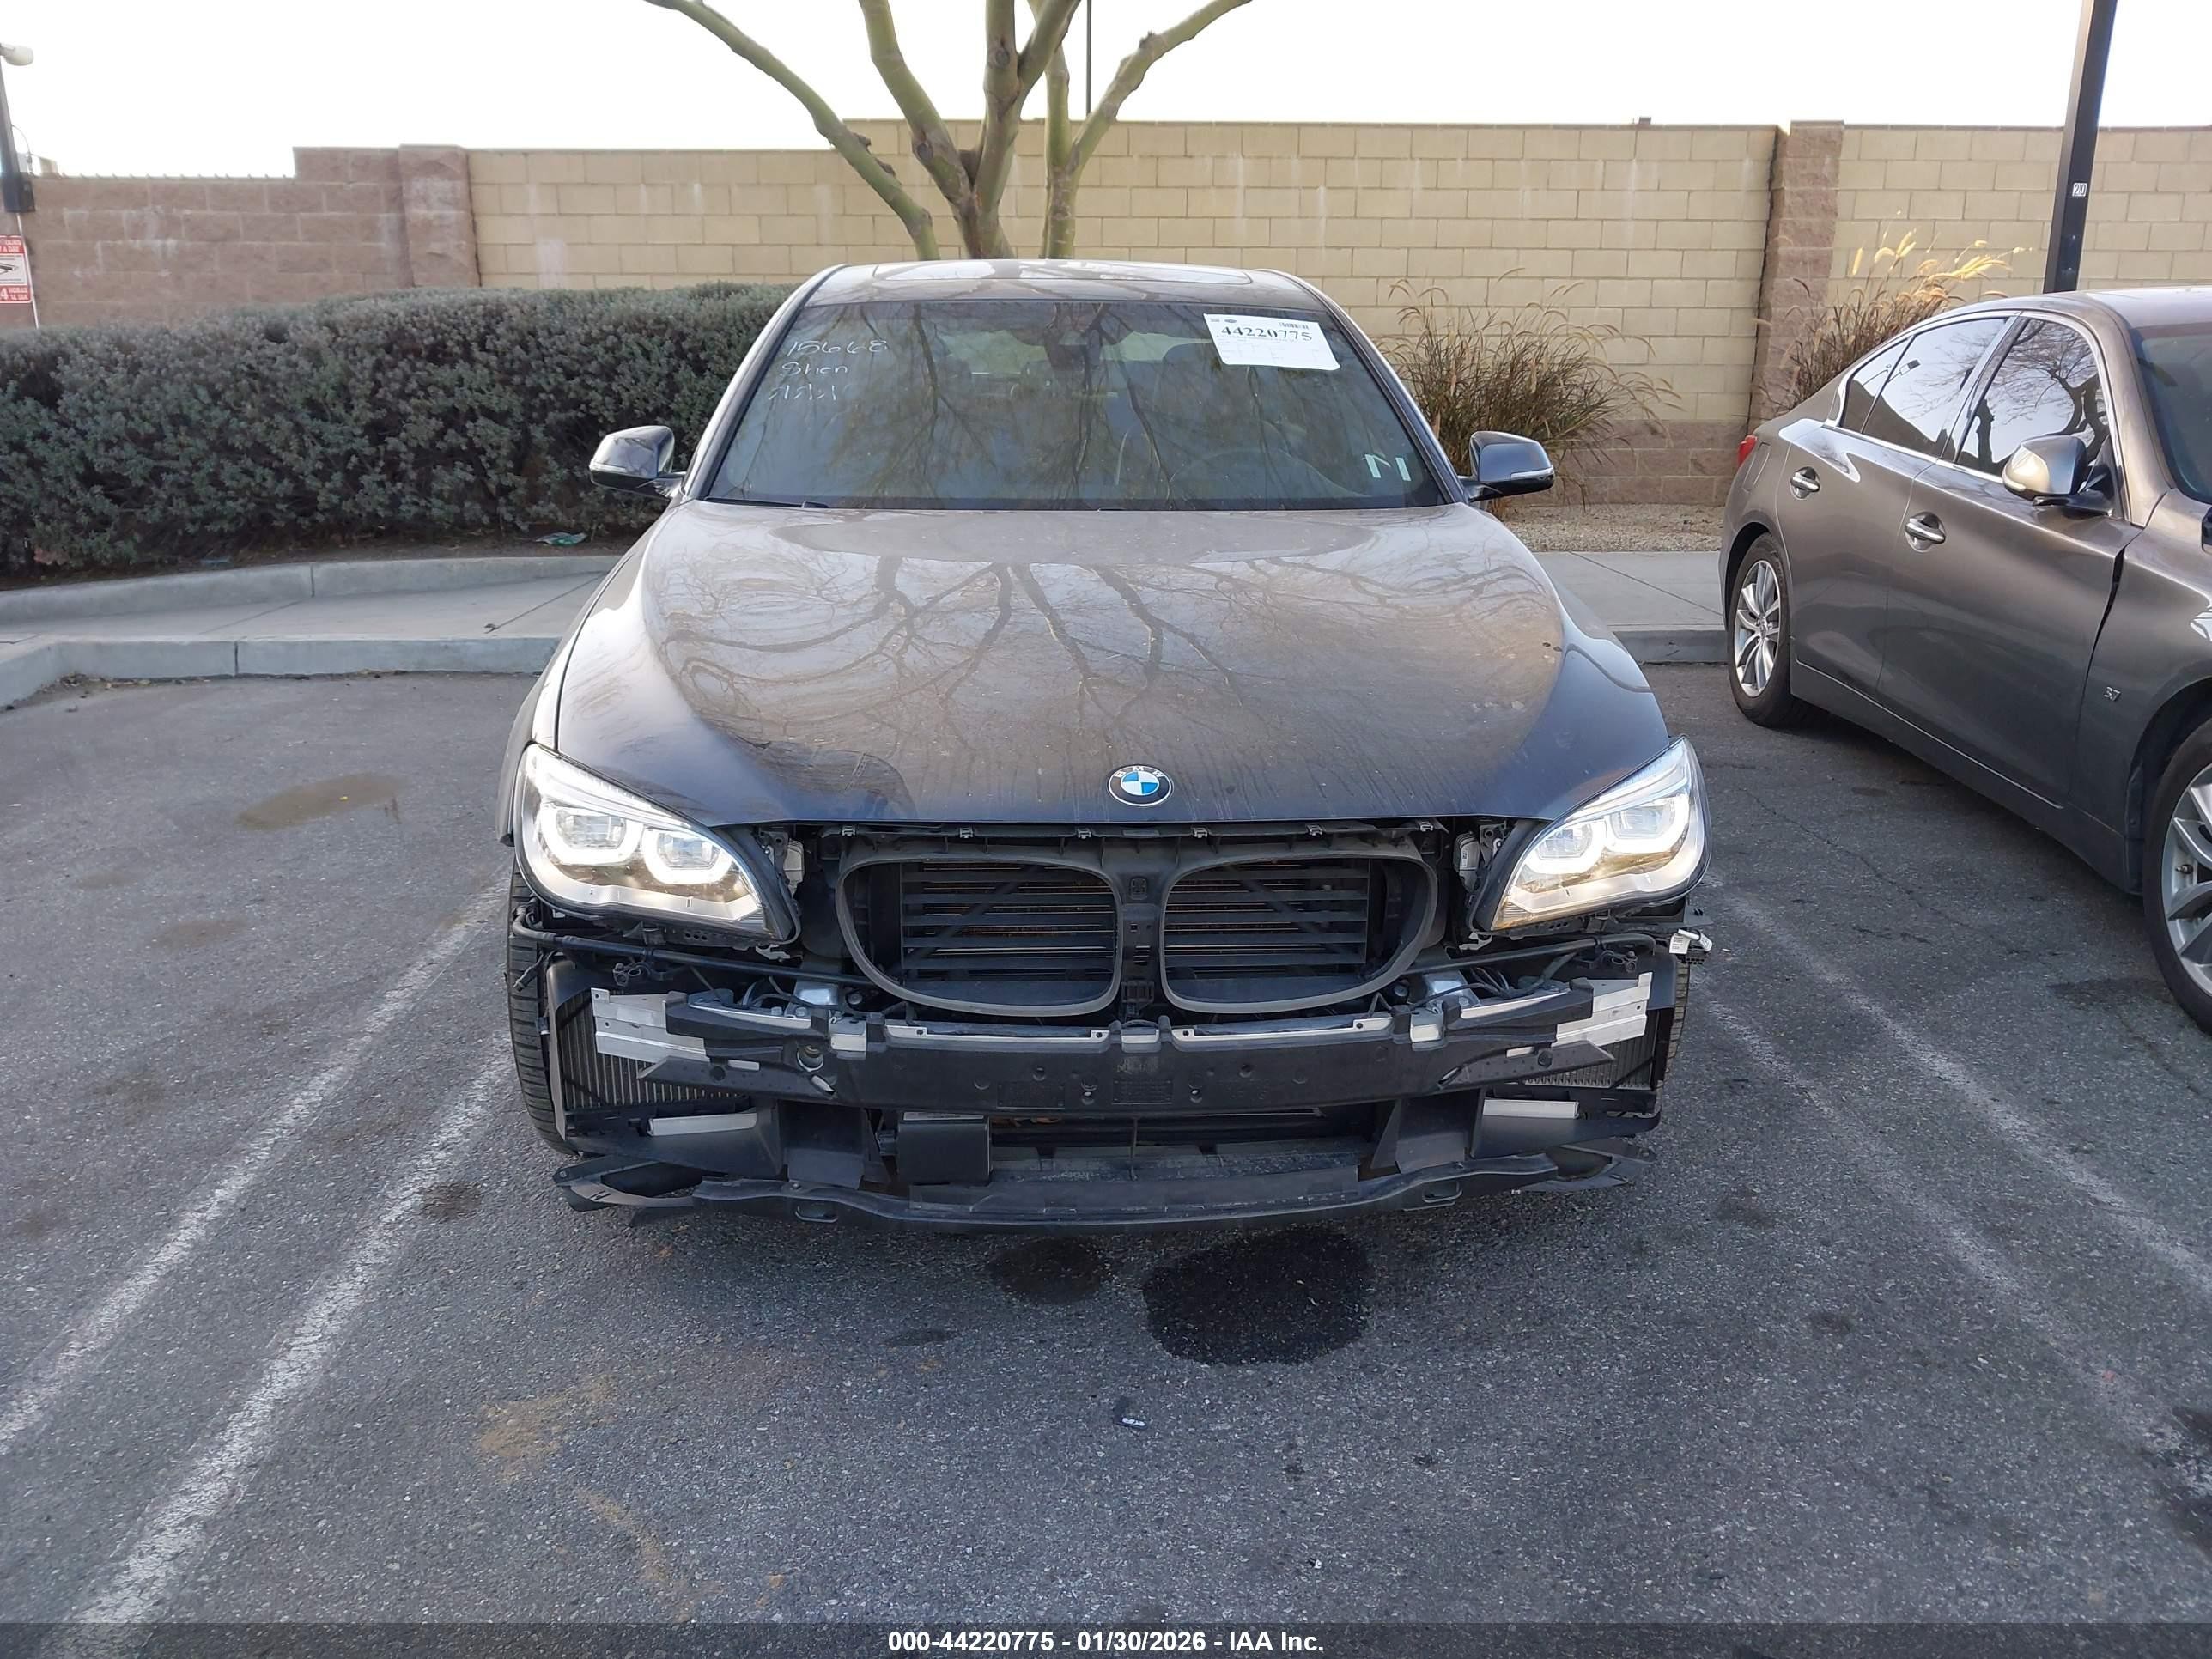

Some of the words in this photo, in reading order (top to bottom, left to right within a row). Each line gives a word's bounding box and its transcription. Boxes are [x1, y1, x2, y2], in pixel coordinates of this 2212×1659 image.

[2074, 184, 2086, 195] 20
[1221, 326, 1312, 341] 44220775
[1115, 766, 1165, 777] BMW
